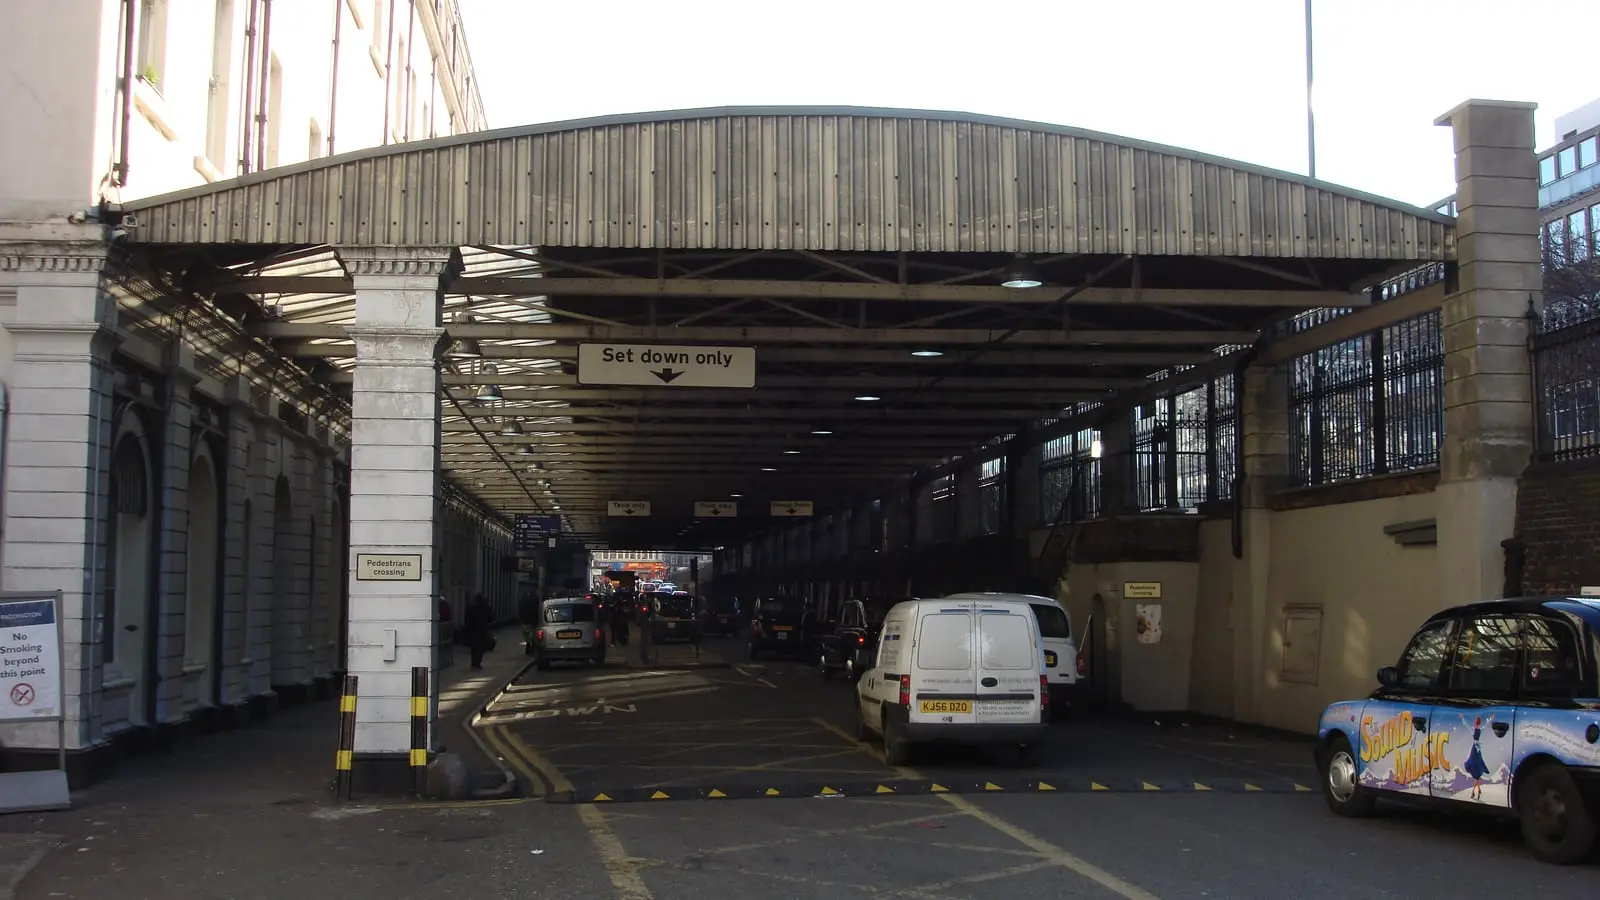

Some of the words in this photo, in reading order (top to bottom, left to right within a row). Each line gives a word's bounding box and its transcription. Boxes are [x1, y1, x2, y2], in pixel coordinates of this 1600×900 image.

[602, 347, 634, 363] Set
[640, 348, 689, 365] down
[695, 350, 733, 368] only
[366, 559, 411, 567] Pedestrians
[373, 568, 406, 577] crossing
[12, 633, 28, 641] No
[0, 644, 42, 655] Smoking
[4, 656, 39, 667] beyond
[0, 669, 17, 679] this
[20, 667, 45, 679] point
